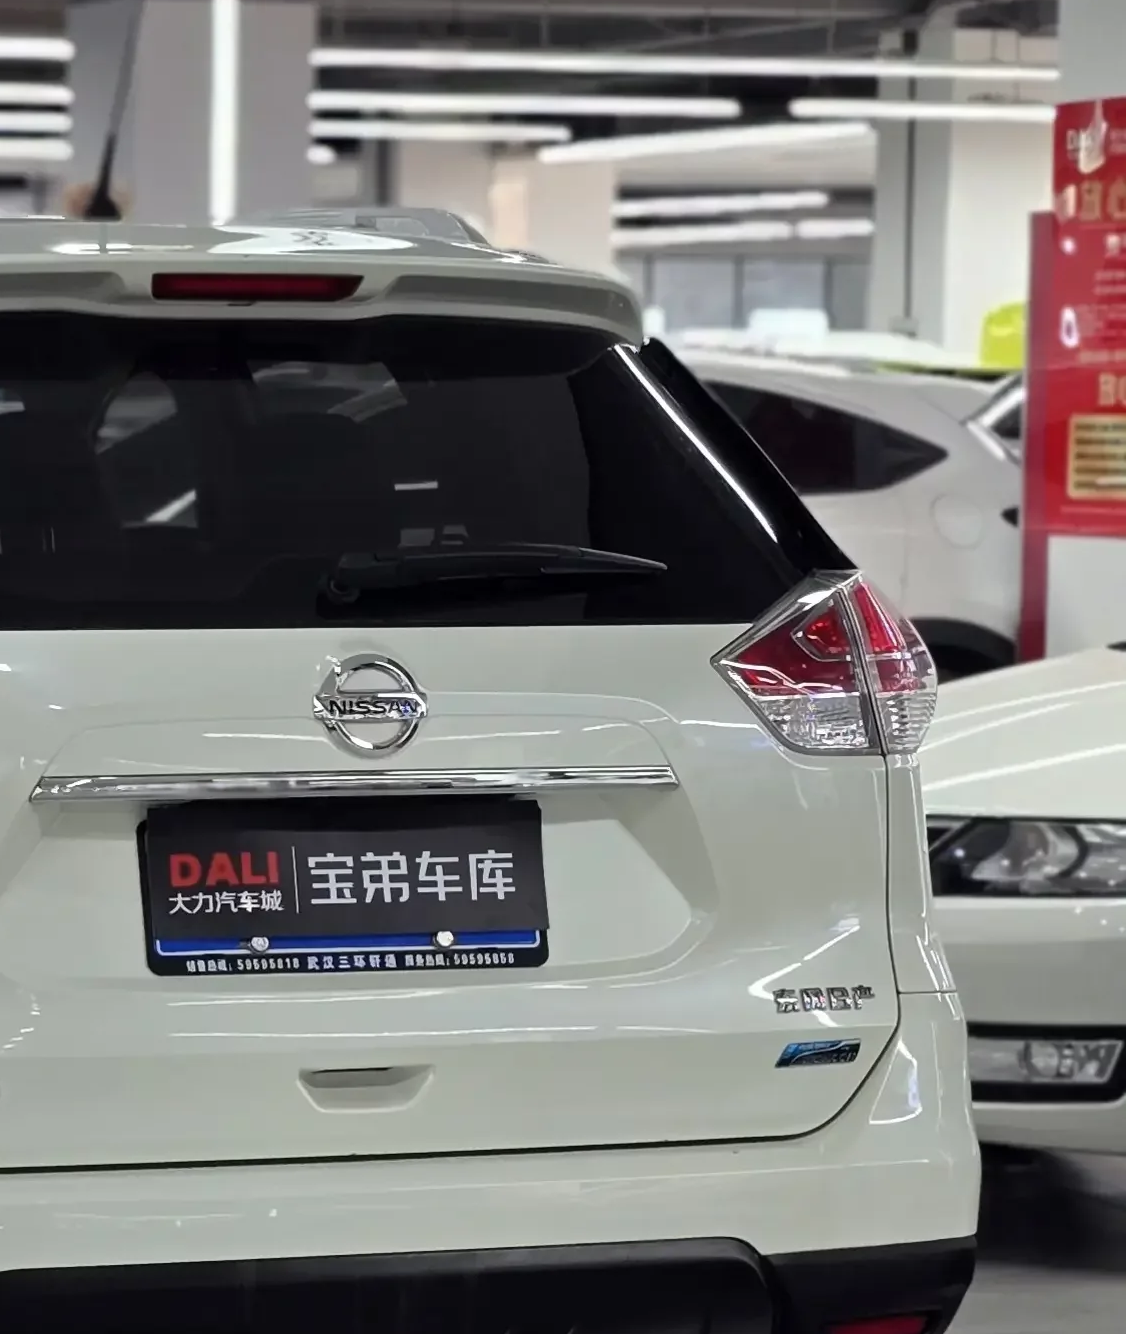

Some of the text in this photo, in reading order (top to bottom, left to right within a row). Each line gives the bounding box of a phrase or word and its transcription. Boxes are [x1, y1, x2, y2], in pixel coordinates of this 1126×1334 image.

[328, 699, 418, 716] NISSAN
[169, 851, 280, 888] DALI
[307, 849, 516, 905] 宝弟车库
[168, 889, 285, 915] 大力汽车城
